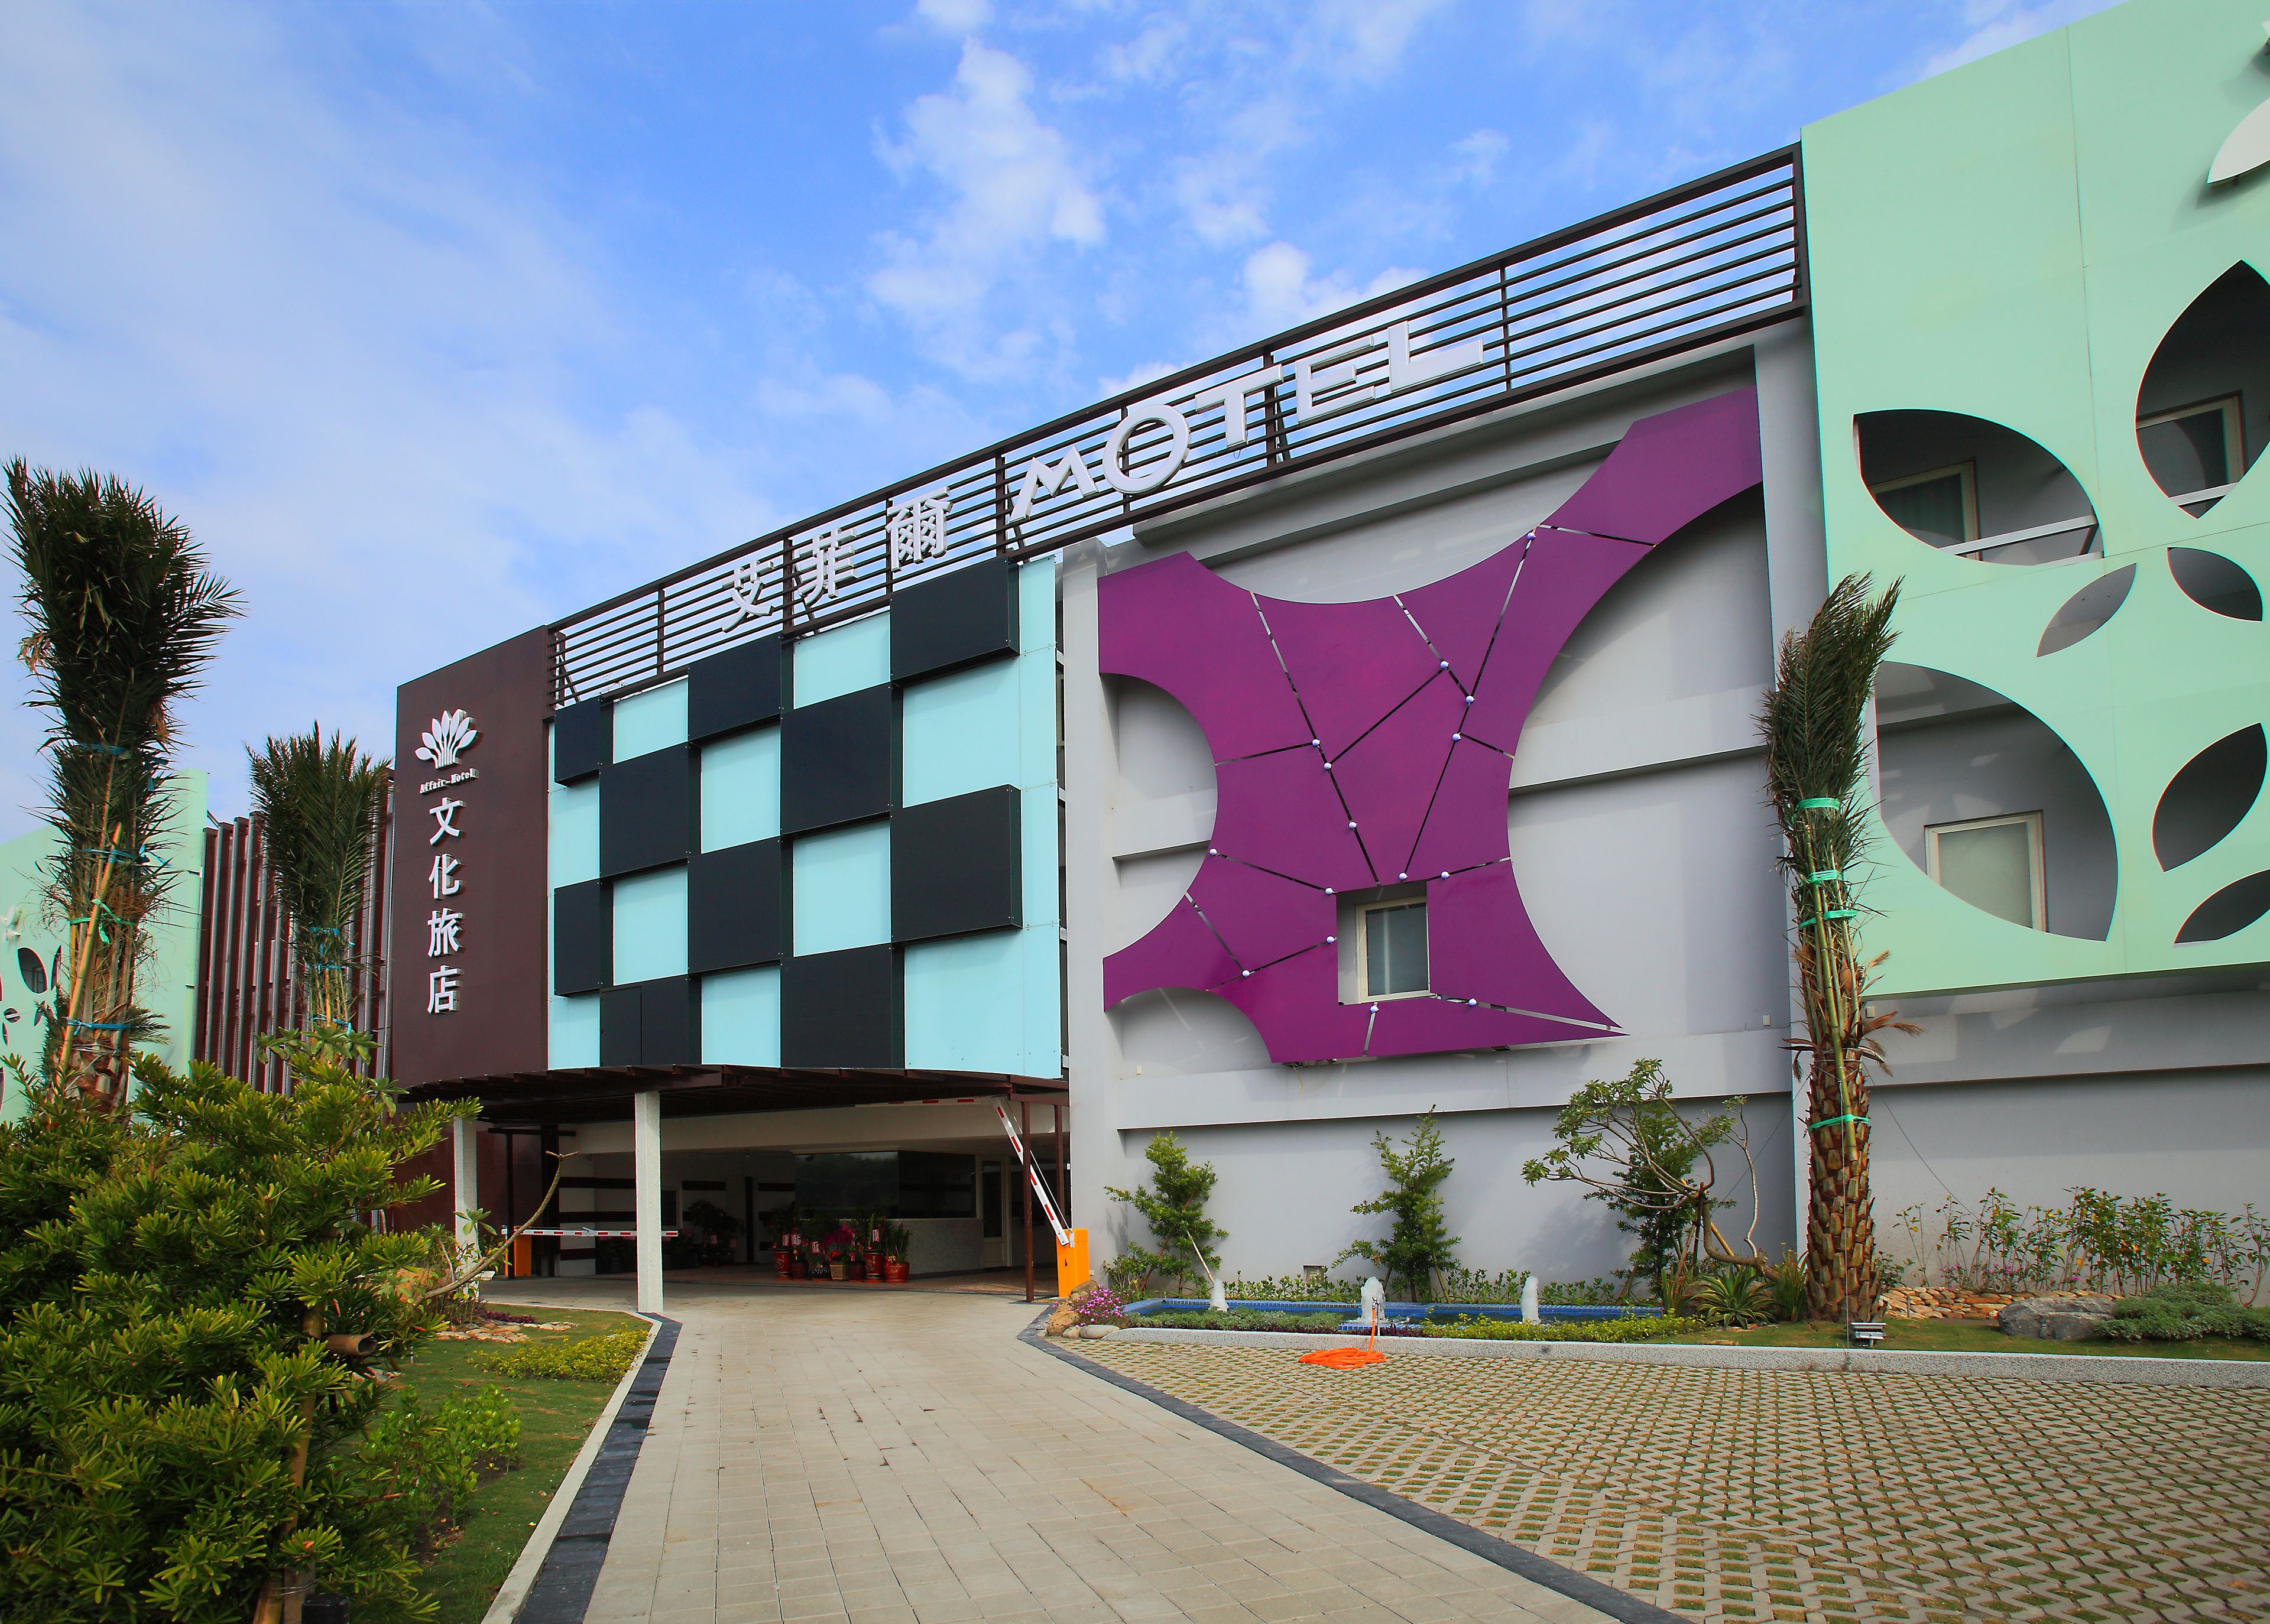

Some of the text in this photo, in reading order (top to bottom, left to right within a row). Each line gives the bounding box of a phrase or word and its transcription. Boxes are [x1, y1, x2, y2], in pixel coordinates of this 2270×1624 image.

[722, 320, 1484, 633] 艾菲爾 MOTEL
[427, 797, 465, 1015] 文化旅店
